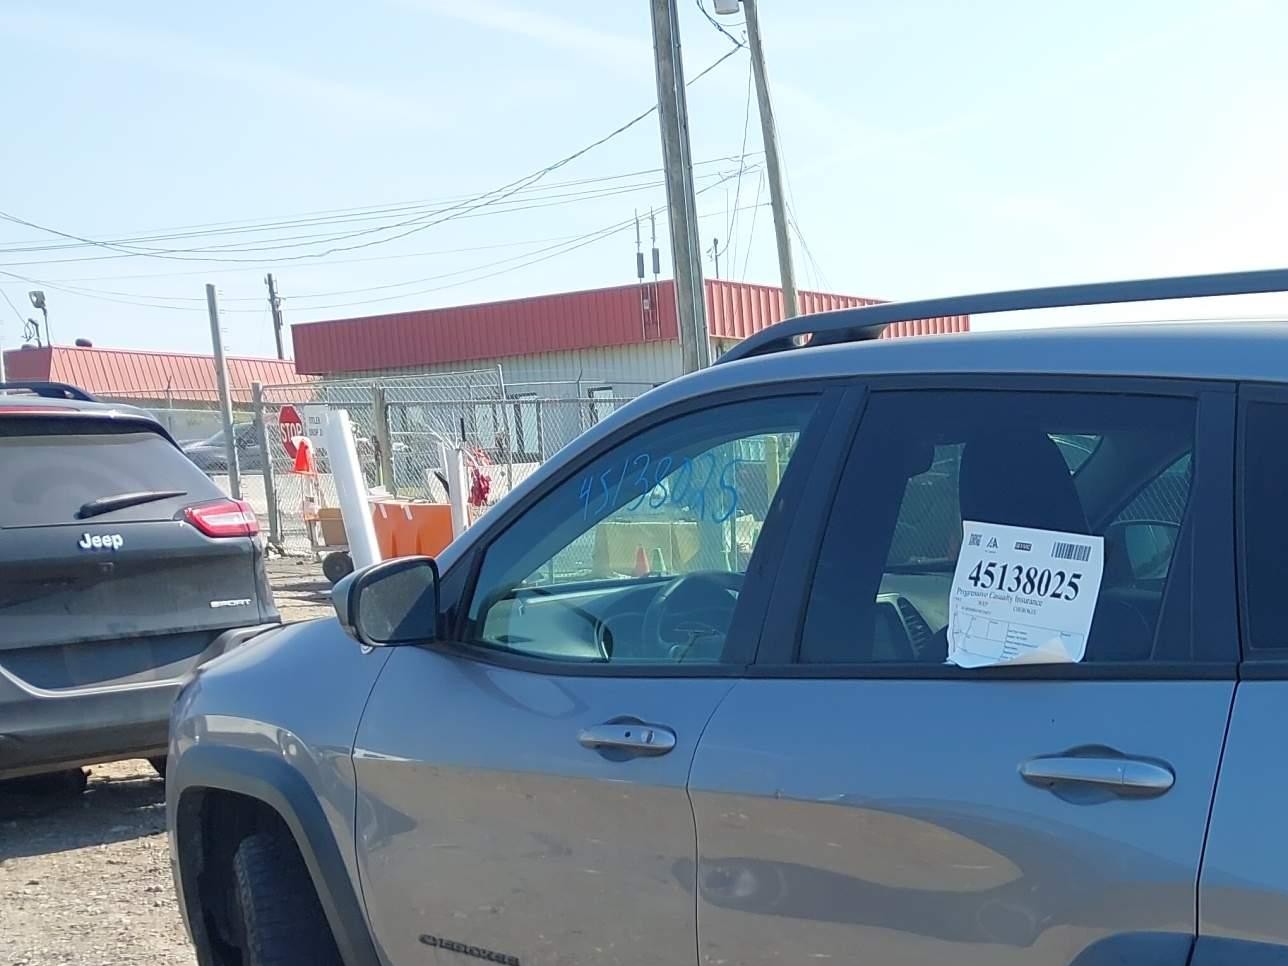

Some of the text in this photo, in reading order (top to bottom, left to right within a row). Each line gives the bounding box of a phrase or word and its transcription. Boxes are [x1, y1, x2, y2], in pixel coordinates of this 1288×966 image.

[280, 422, 303, 442] STOP
[578, 453, 752, 524] 45138025
[79, 532, 124, 550] Jeep
[968, 560, 1082, 601] 45138025
[210, 599, 251, 608] SPORT
[957, 587, 987, 598] Progressive
[988, 591, 1013, 604] Casualty
[1015, 595, 1043, 607] Insurance
